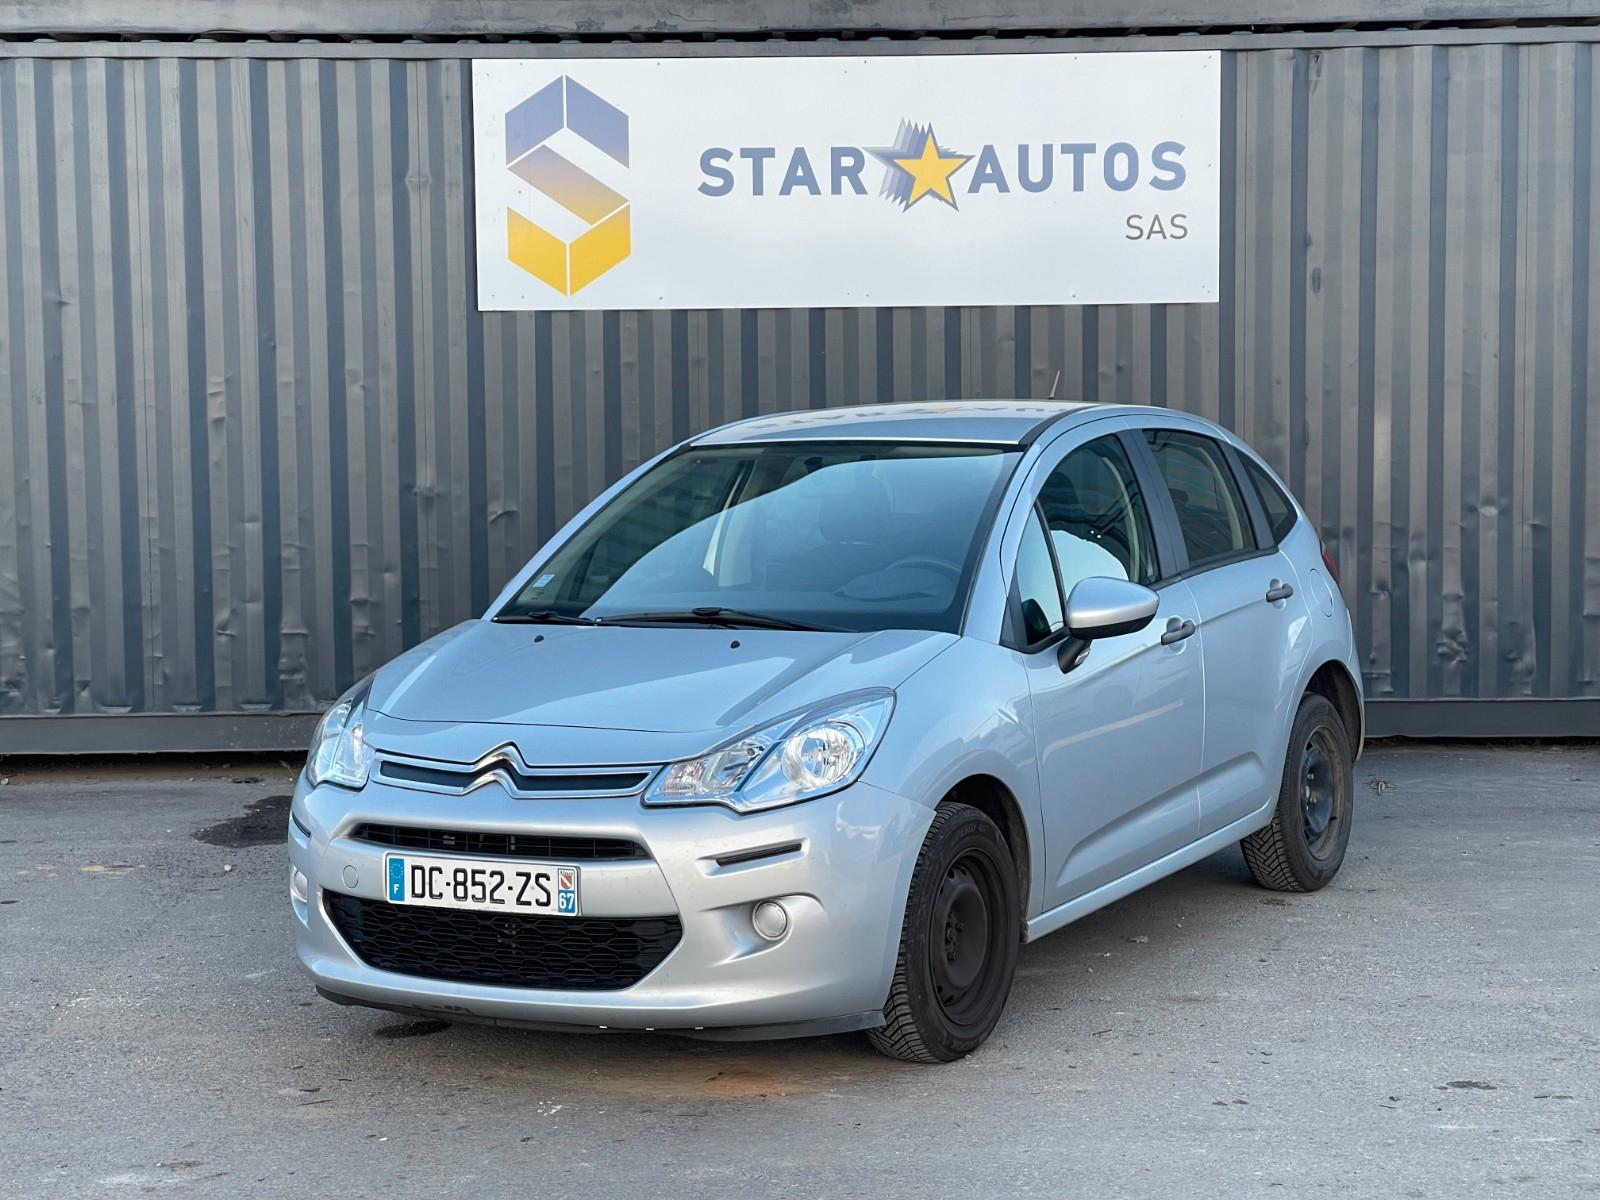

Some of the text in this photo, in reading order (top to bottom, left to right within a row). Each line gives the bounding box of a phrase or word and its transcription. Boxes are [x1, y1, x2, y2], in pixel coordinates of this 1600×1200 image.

[698, 140, 1186, 197] STAR AUTOS
[1125, 213, 1188, 240] SAS
[393, 884, 400, 895] F
[411, 864, 551, 907] DC-852-ZS
[559, 892, 575, 910] 67
